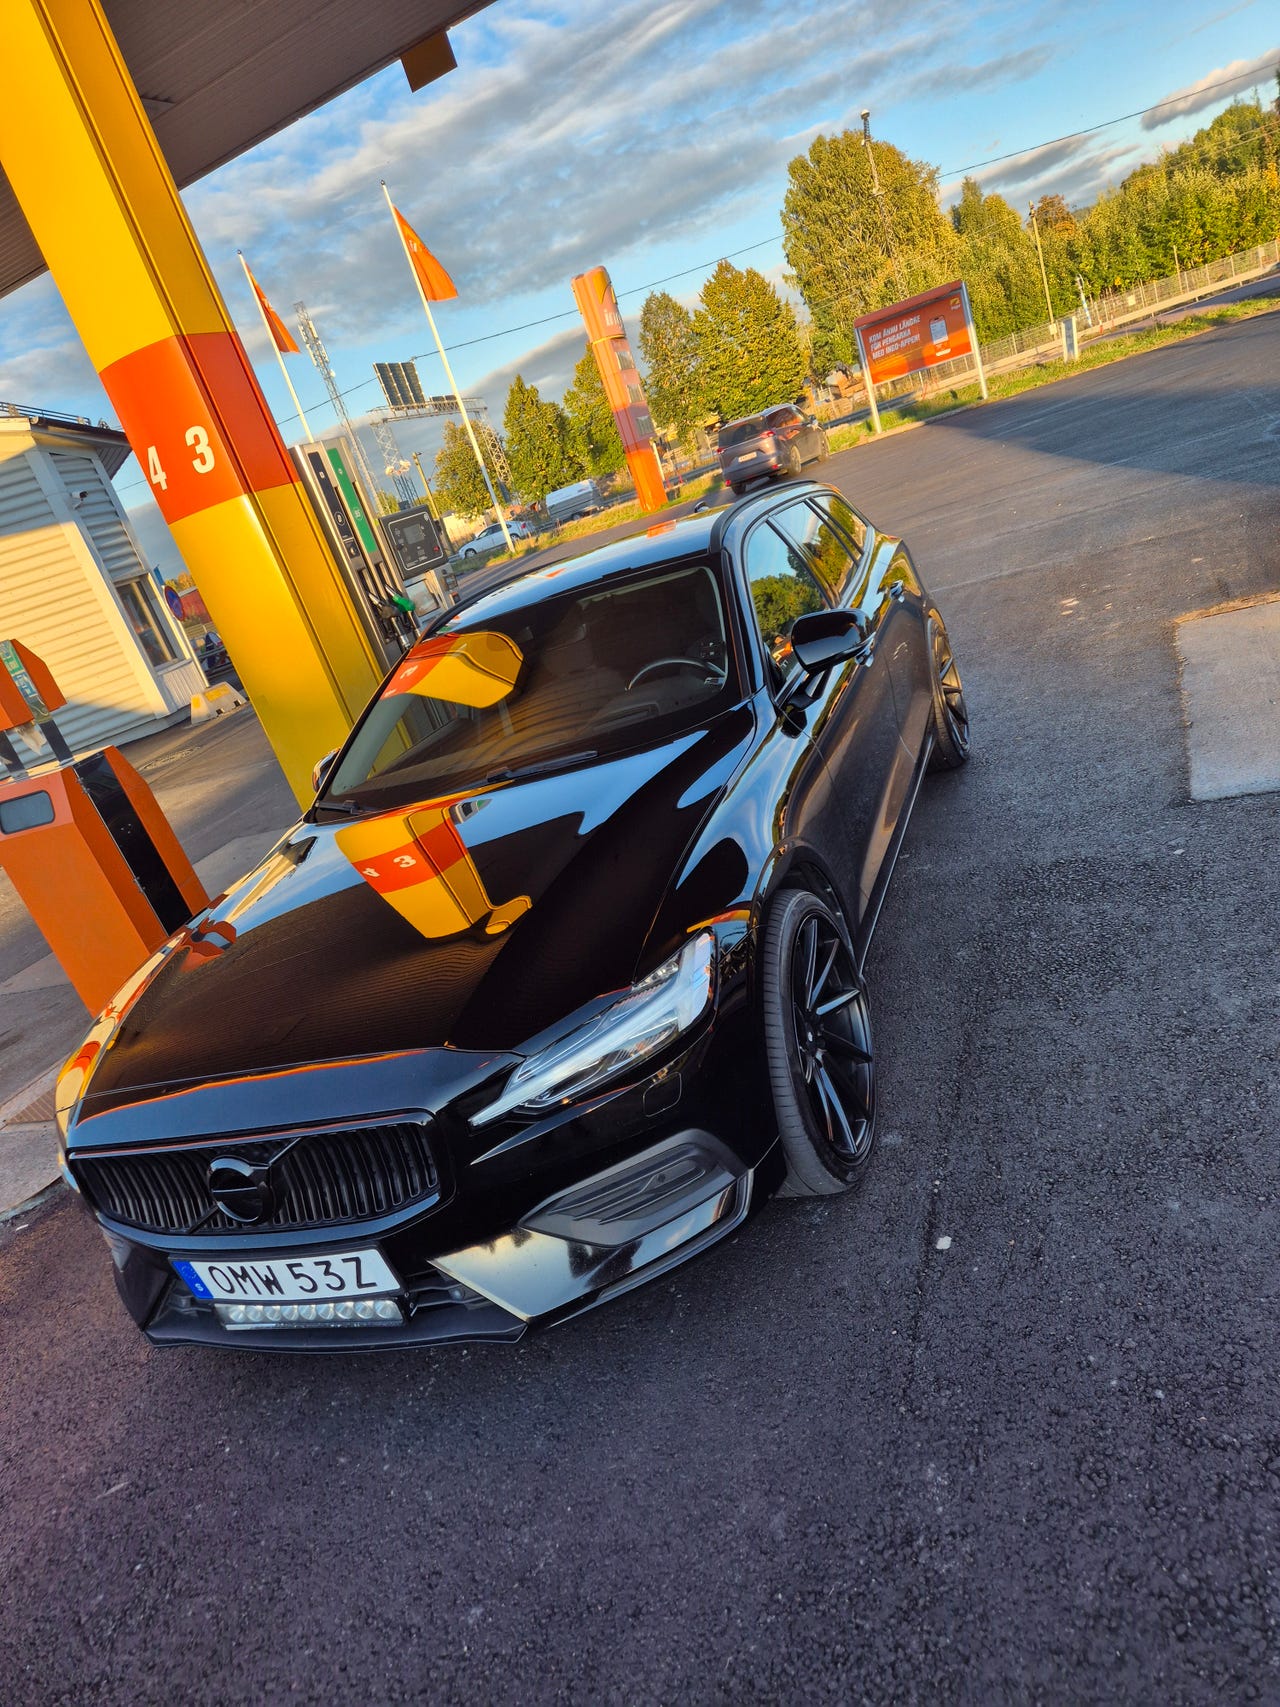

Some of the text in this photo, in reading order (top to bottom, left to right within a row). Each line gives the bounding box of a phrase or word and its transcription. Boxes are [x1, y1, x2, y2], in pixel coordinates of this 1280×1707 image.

[872, 349, 885, 360] MED
[147, 425, 215, 491] 4 3
[208, 1256, 378, 1295] OMW 53Z
